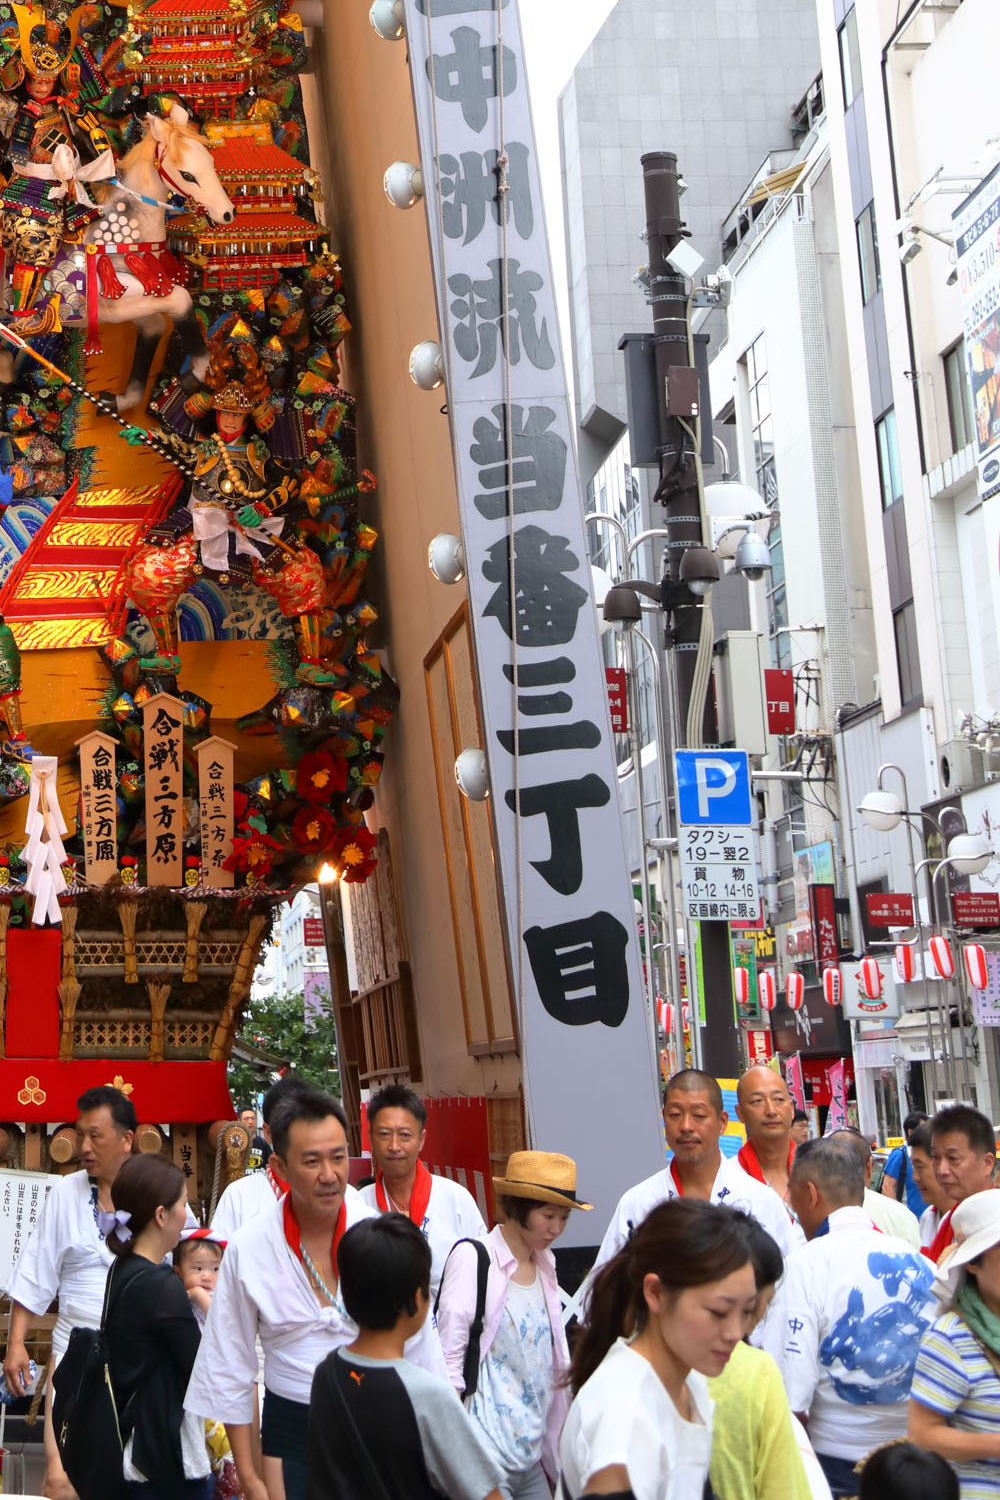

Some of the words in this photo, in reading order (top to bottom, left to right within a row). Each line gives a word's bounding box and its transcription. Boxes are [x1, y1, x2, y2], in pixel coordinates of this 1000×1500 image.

[767, 701, 790, 713] 丁目
[92, 745, 115, 861] 合戦三方原
[148, 708, 182, 864] 合戦三方原
[695, 758, 736, 817] P
[207, 761, 227, 868] 合戦三方原
[687, 830, 744, 844] タクシー
[687, 883, 716, 897] 10-12
[724, 883, 753, 897] 14-16
[689, 903, 756, 918] 区画線内に限る
[11, 1183, 26, 1268] 山笠には手をふれない
[785, 1317, 804, 1355] 中二
